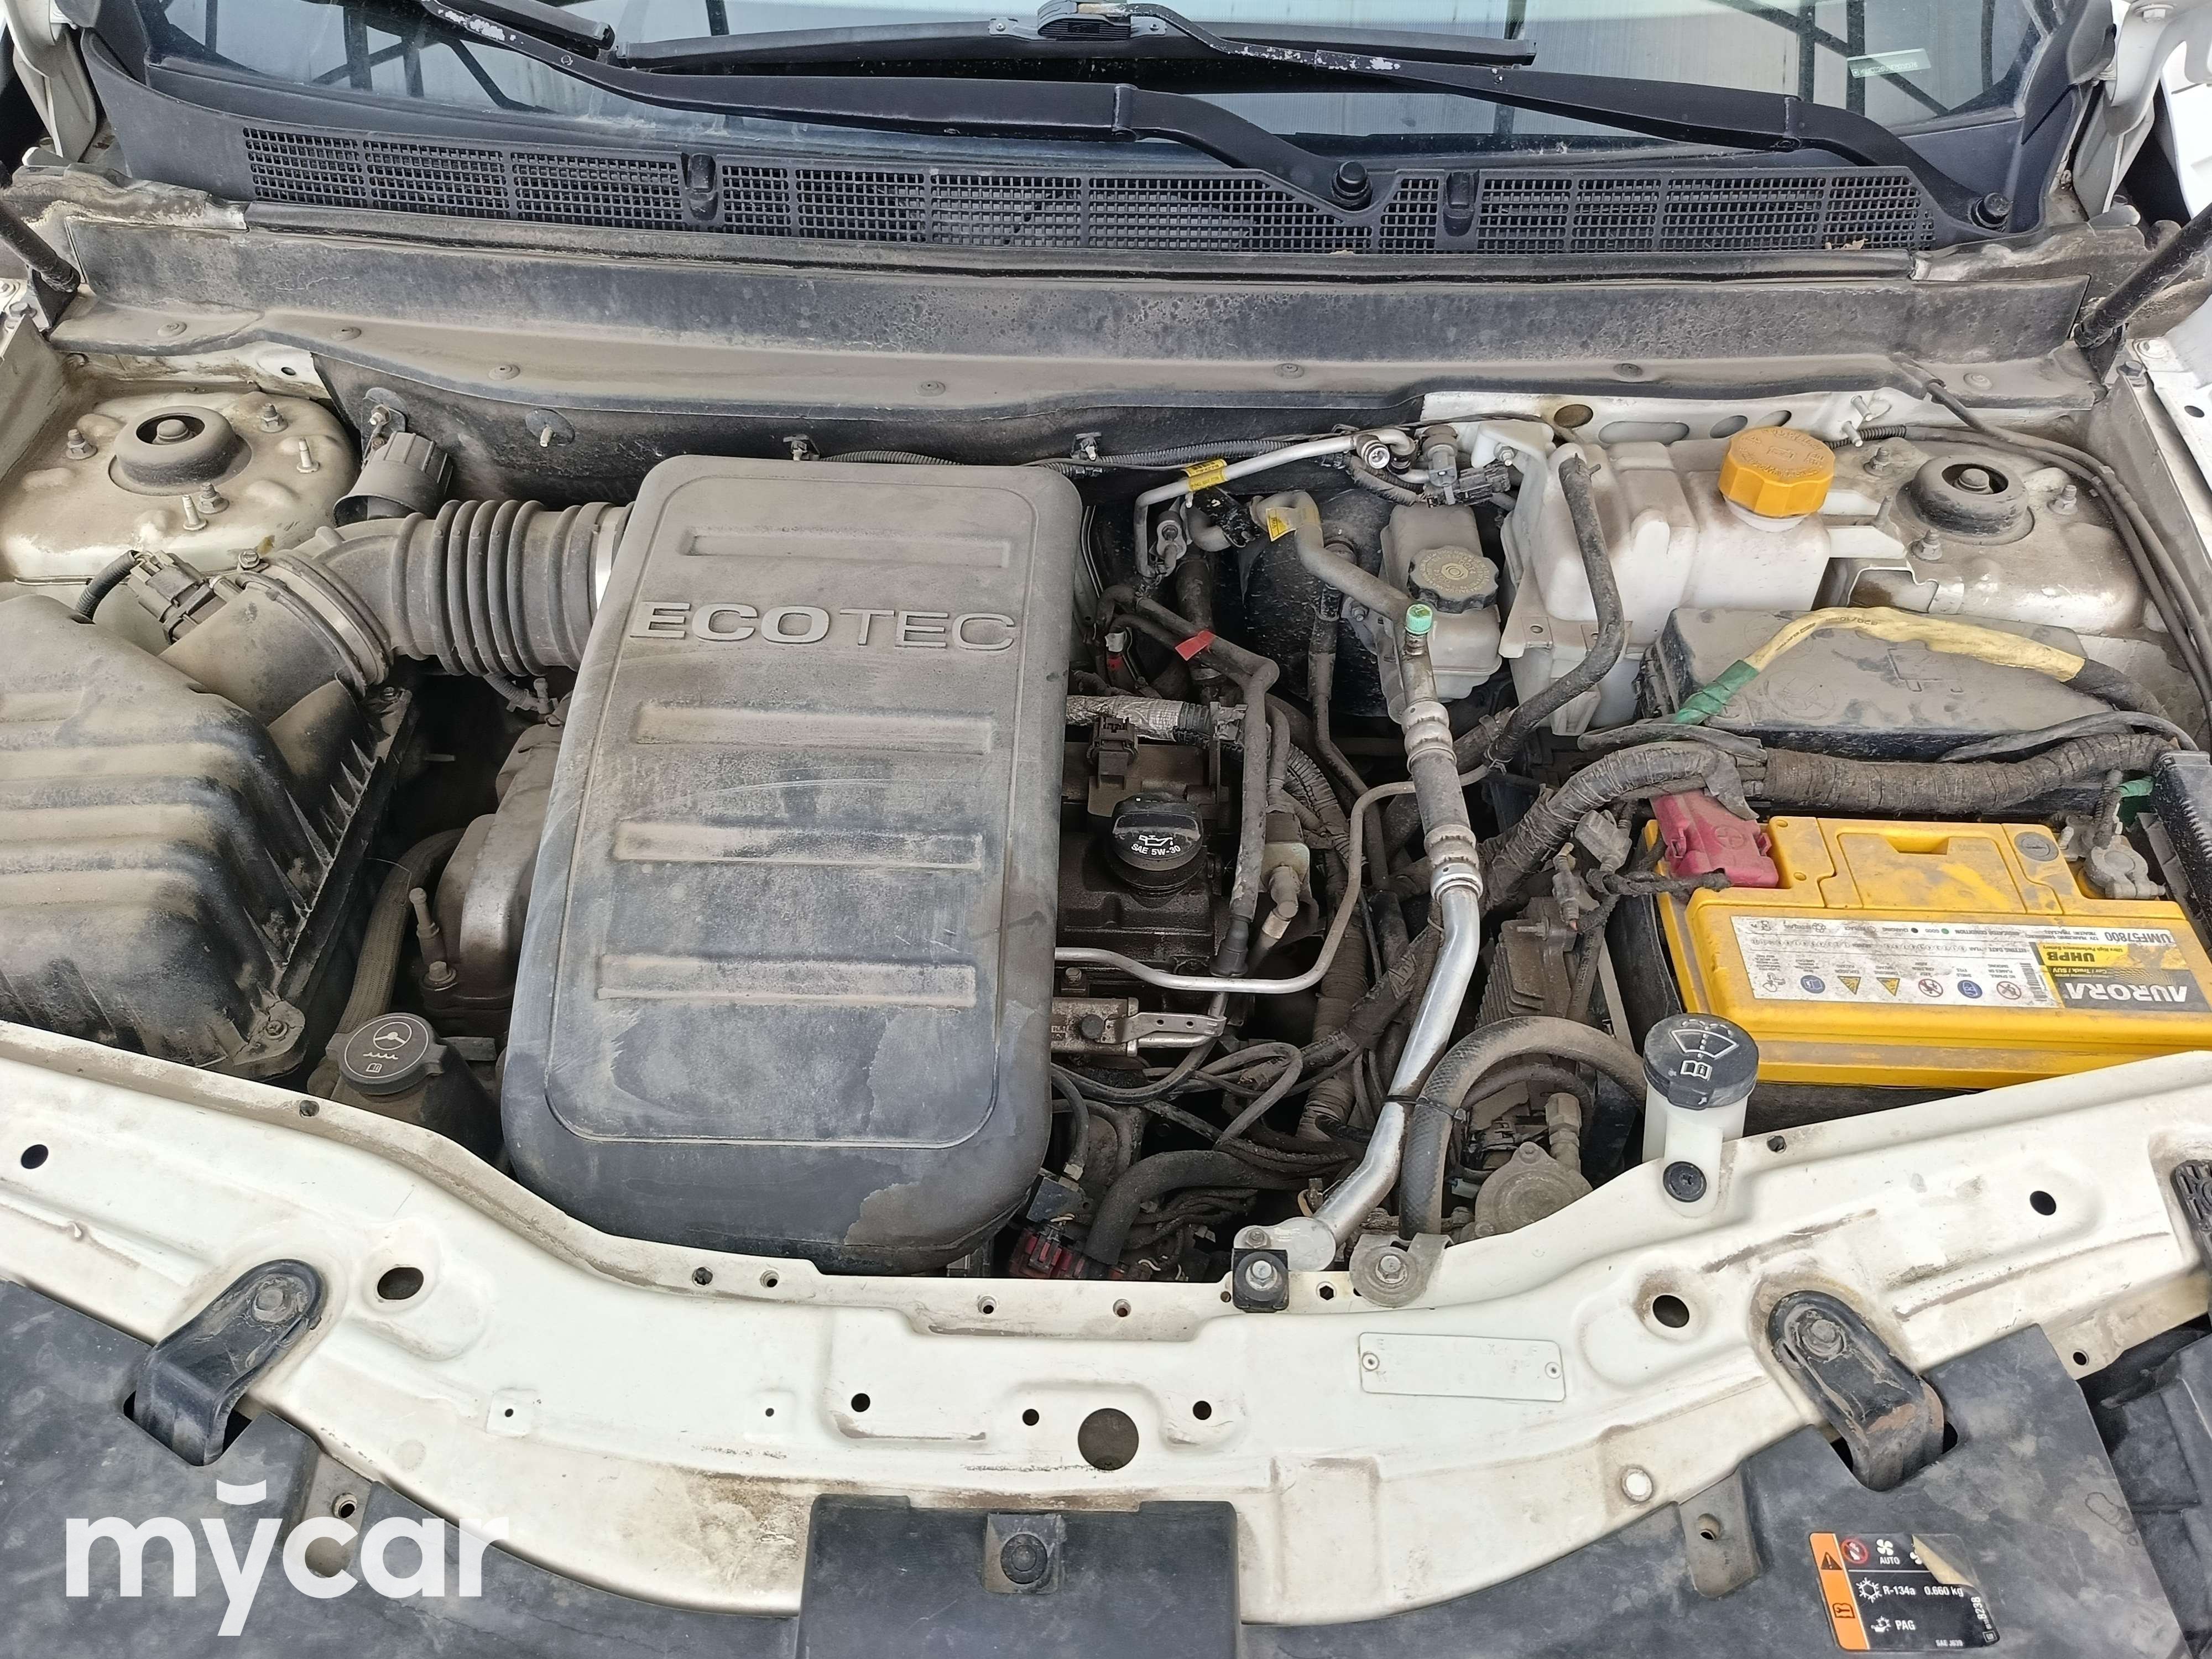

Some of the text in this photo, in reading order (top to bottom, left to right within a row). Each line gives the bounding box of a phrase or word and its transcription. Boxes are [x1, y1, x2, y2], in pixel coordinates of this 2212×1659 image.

[629, 601, 1016, 650] ECOTEC
[1131, 843, 1181, 855] SAE 5W-30
[2104, 932, 2172, 943] UMF57800
[2047, 952, 2095, 963] UHPB
[2064, 983, 2188, 1003] AURORA
[1880, 1557, 1900, 1565] AUTO
[1882, 1585, 1964, 1598] R-134a 0.660 kg
[1895, 1619, 1916, 1631] PAG
